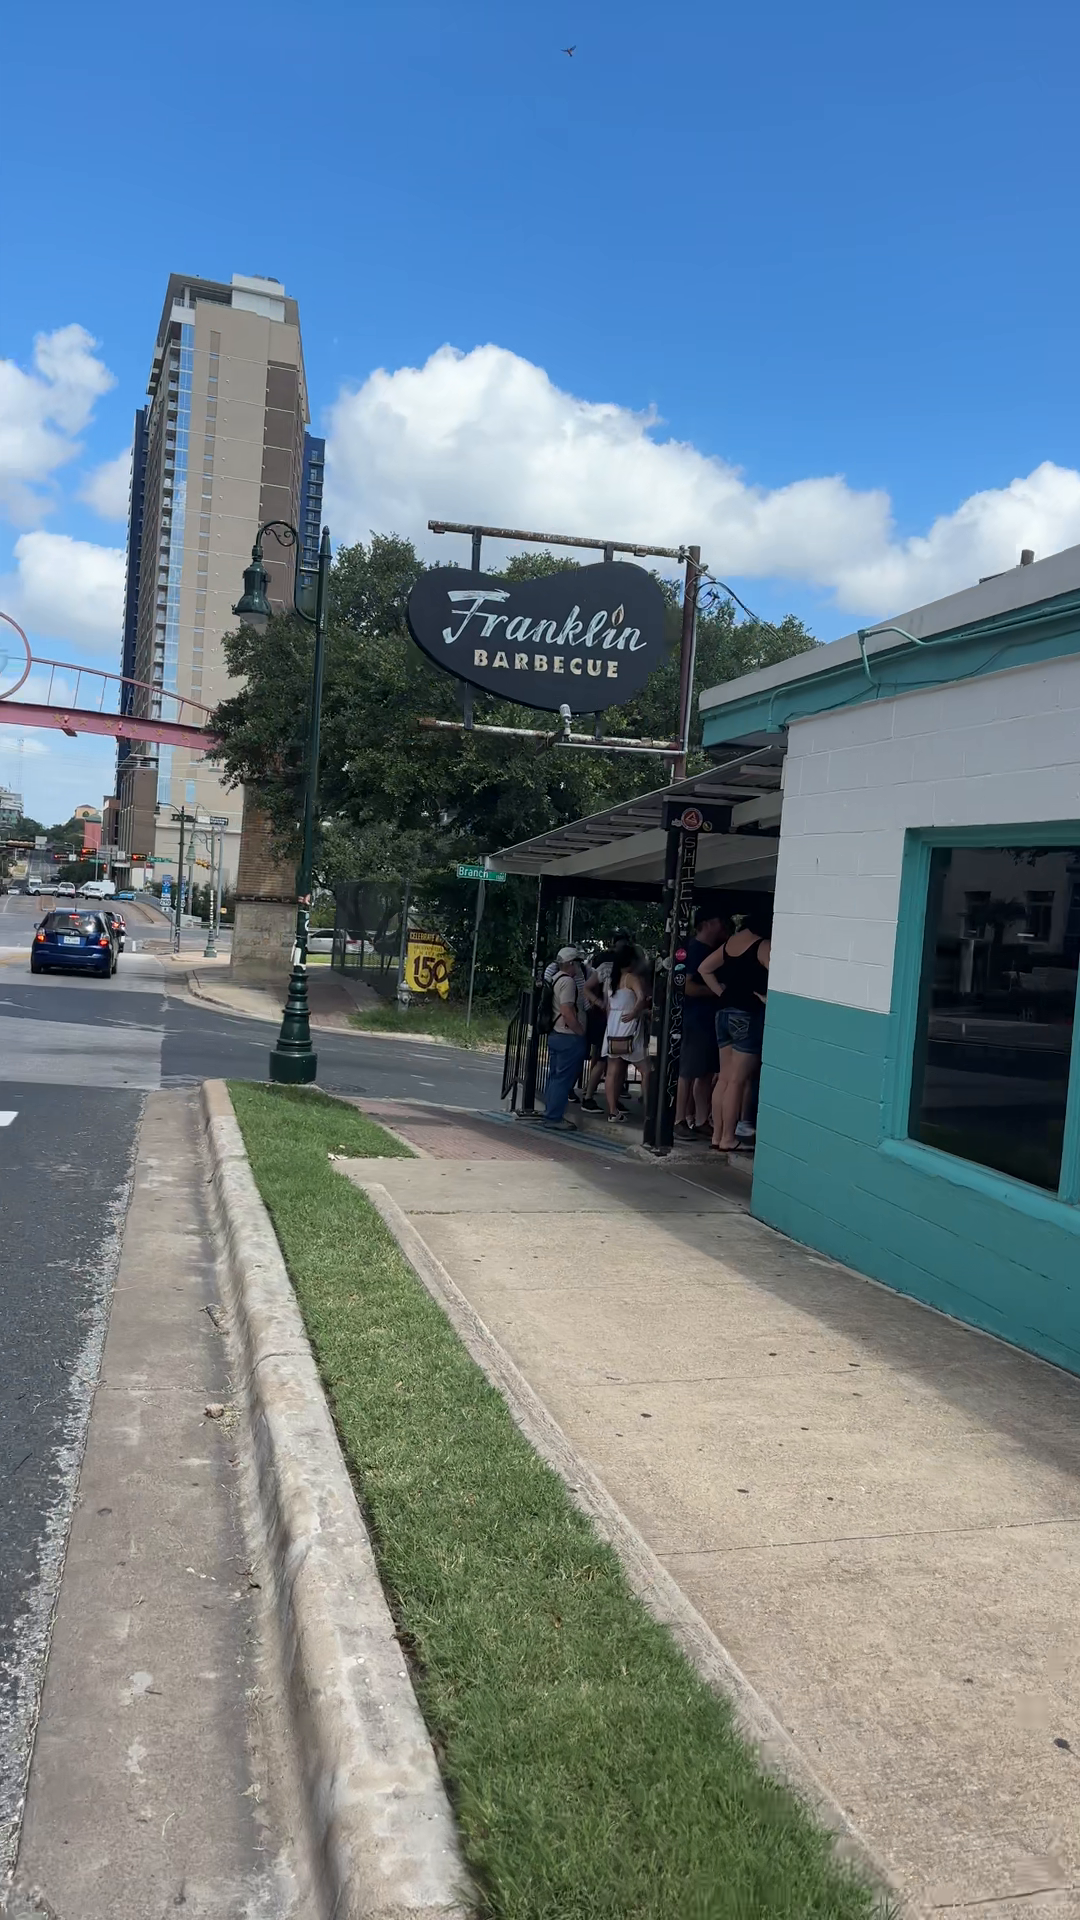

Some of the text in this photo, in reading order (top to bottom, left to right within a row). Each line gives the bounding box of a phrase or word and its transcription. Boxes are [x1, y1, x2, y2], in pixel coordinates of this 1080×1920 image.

[442, 589, 647, 652] Franklin
[473, 649, 619, 678] BARBECUE
[458, 866, 489, 879] Branch
[413, 955, 448, 989] 150
